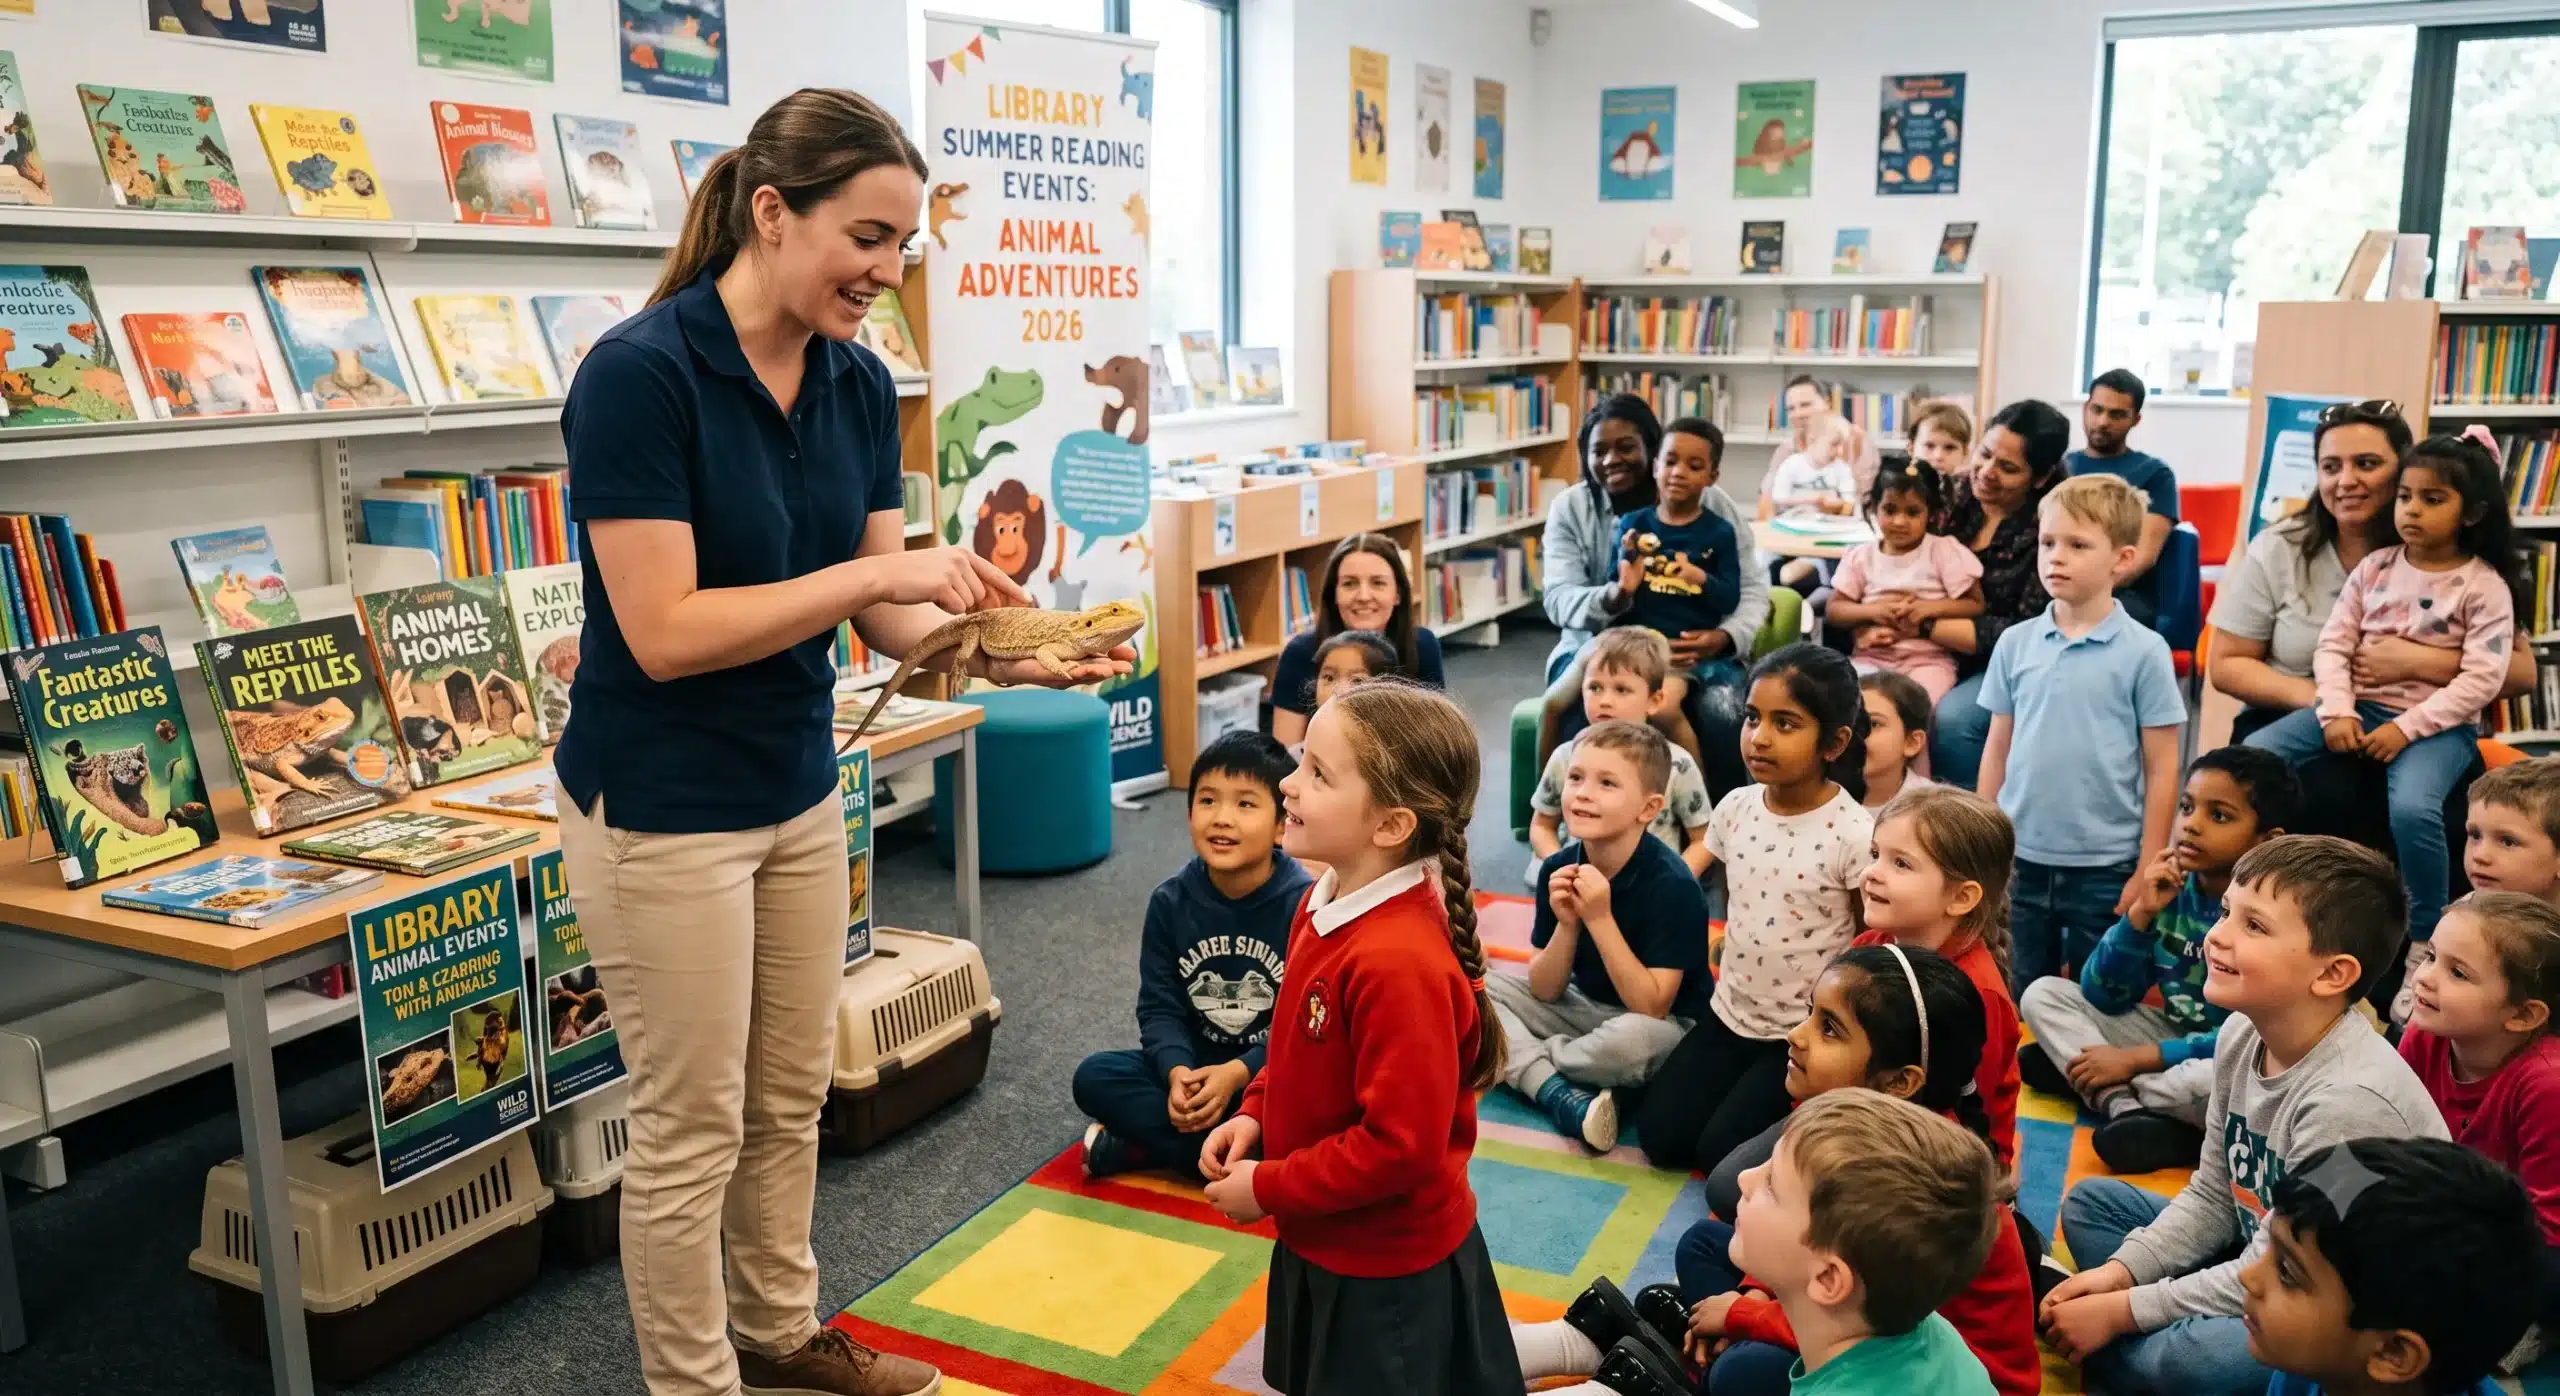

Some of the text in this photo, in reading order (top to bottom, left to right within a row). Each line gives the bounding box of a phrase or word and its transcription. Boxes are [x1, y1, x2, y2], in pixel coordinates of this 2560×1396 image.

[988, 84, 1104, 127] LIBRARY
[288, 133, 351, 153] Reptiles
[943, 128, 1145, 169] SUMMER READING
[1003, 171, 1096, 203] EVENTS:
[1000, 218, 1101, 255] ANIMAL
[957, 263, 1139, 299] ADVENTURES
[1022, 309, 1084, 343] 2026
[391, 601, 491, 640] ANIMAL
[242, 634, 338, 670] MEET THE
[398, 627, 493, 667] HOMES
[37, 651, 157, 699] Fantastic
[230, 653, 362, 707] REPTILES
[43, 684, 168, 729] Creatures
[365, 879, 502, 961] LIBRARY
[545, 897, 575, 923] ANI
[371, 918, 508, 985] ANIMAL EVENTS
[383, 949, 501, 1007] TON & CZARRING
[394, 969, 497, 1021] WITH ANIMALS
[497, 1090, 527, 1112] WILD
